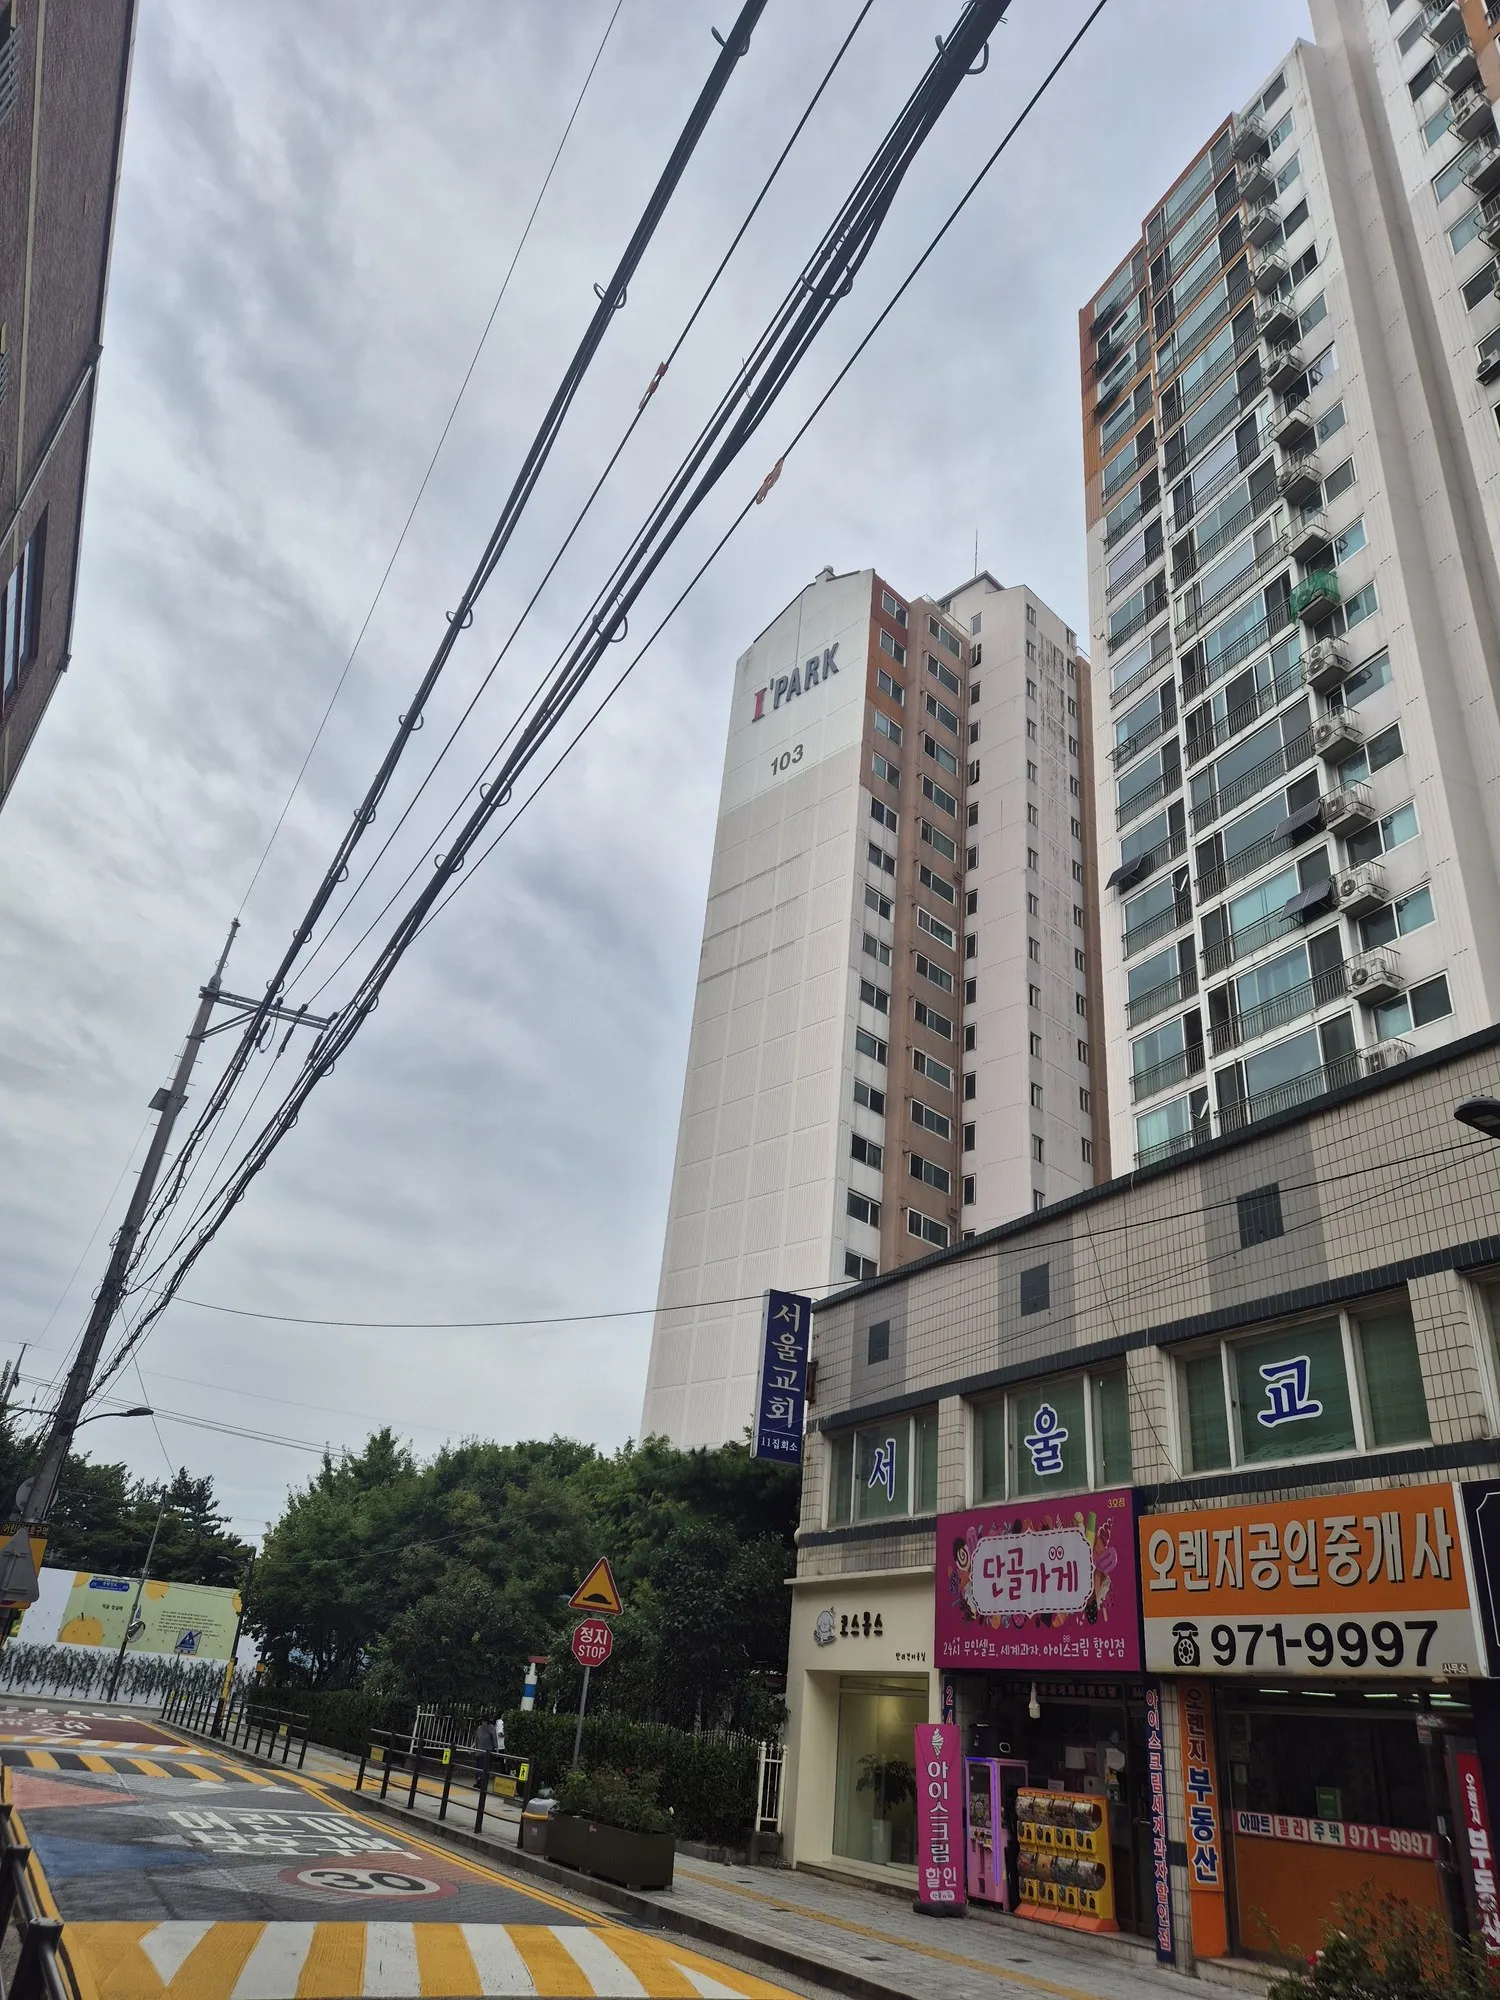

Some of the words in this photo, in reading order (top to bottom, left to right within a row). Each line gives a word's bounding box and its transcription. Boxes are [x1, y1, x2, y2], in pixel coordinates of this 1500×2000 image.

[752, 642, 839, 723] I'PARK
[770, 744, 804, 776] 103
[765, 1303, 804, 1429] 서울교회
[761, 1437, 798, 1452] 11집회소
[1107, 1496, 1126, 1508] 3호점
[1149, 1507, 1453, 1590] 오렌지공인중개사
[983, 1546, 1079, 1600] 단골가게
[580, 1626, 608, 1645] 정지
[943, 1641, 960, 1657] 24시
[1043, 1638, 1090, 1658] 아이스크림
[1093, 1637, 1126, 1658] 할인점
[1211, 1620, 1438, 1667] 971-9997
[578, 1644, 606, 1659] STOP
[1442, 1661, 1468, 1674] 사무소
[1184, 1687, 1208, 1763] 오렌지
[167, 1810, 372, 1836] 어린이
[928, 1761, 950, 1863] 아이스크림
[1187, 1766, 1218, 1884] 부동산
[191, 1830, 423, 1860] 보호구역
[1239, 1813, 1271, 1833] 아파트
[1349, 1825, 1433, 1856] 971-9997
[311, 1871, 427, 1892] 30
[926, 1866, 957, 1888] 할인
